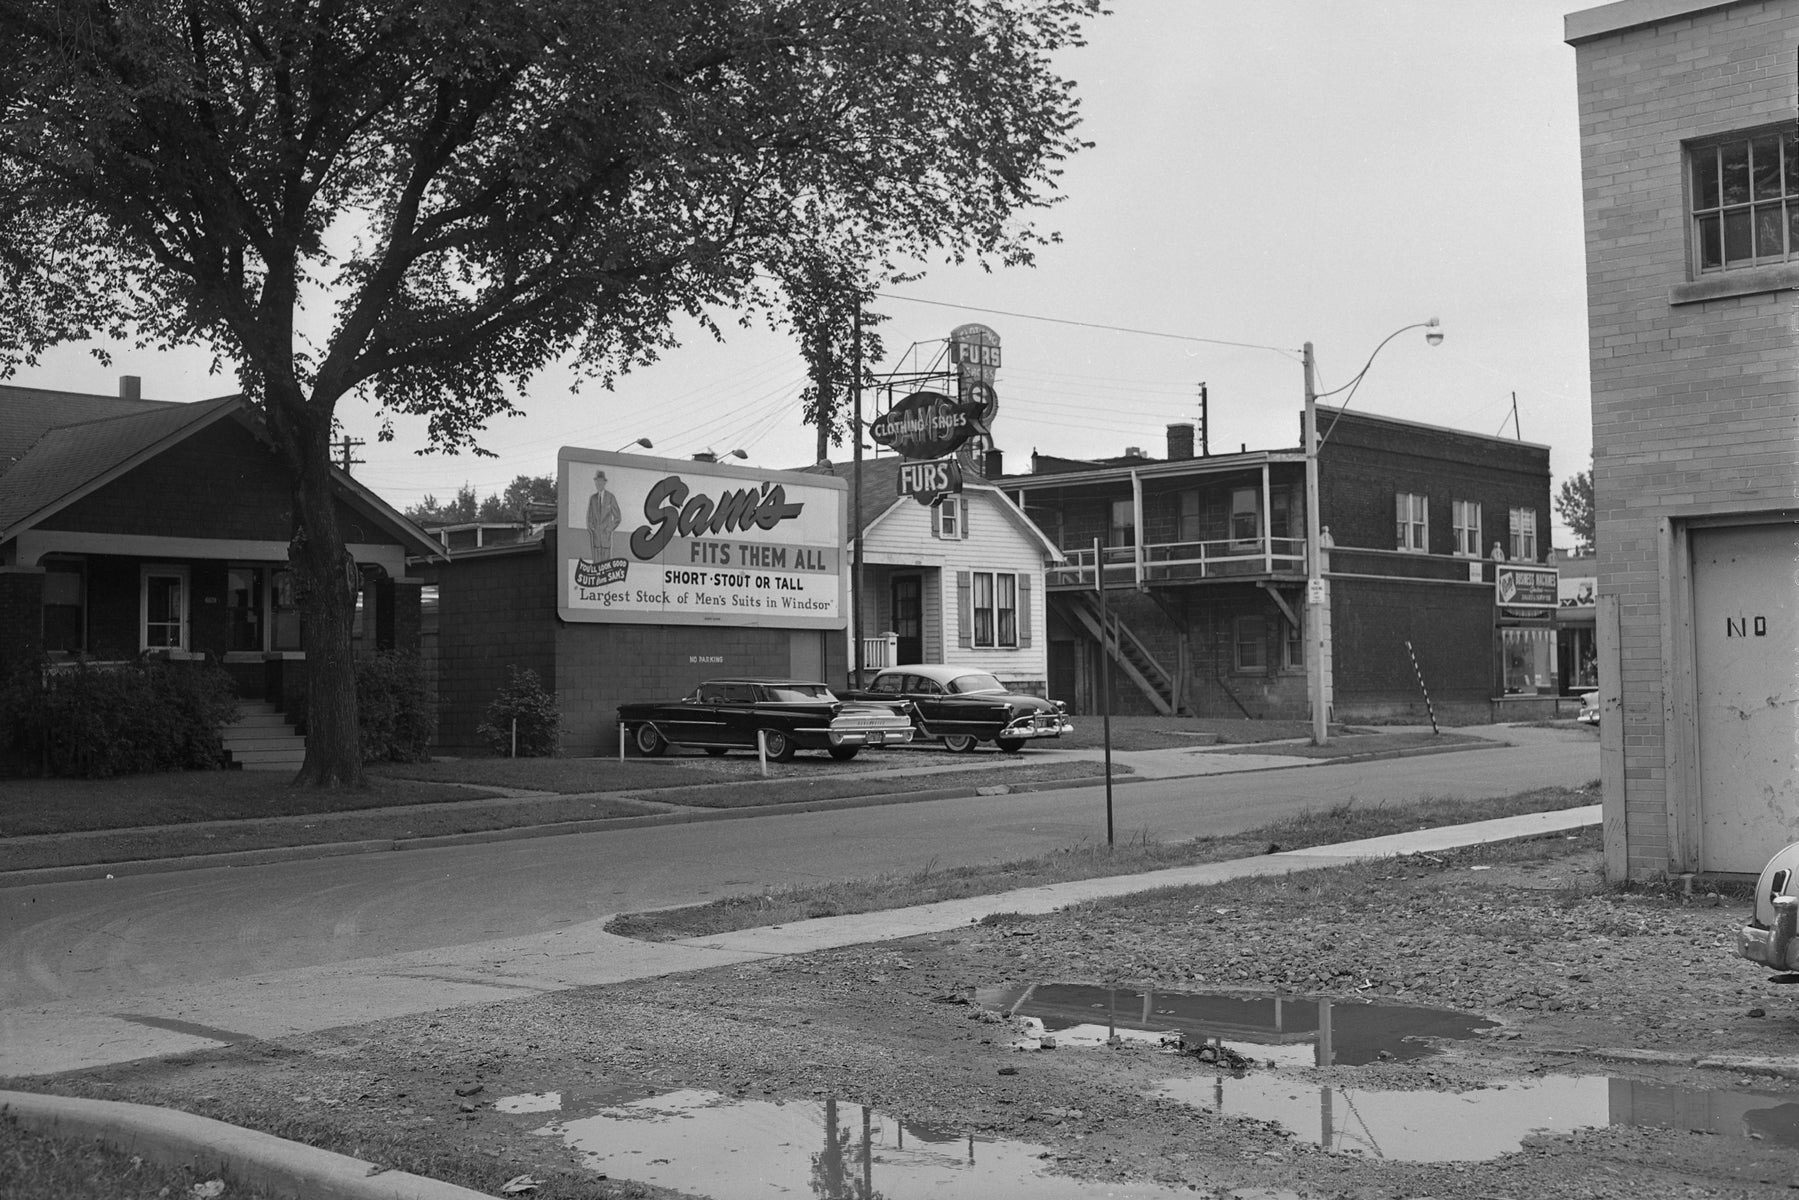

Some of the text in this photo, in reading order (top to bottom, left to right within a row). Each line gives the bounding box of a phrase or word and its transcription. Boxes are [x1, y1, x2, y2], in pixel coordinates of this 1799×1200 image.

[959, 343, 1000, 367] FURS
[874, 412, 967, 438] CLOTHING SHOES
[901, 463, 949, 494] FURS
[630, 476, 804, 561] Sam's
[598, 562, 612, 571] LOOK
[612, 559, 627, 568] GOOD
[690, 541, 826, 571] FITS THEM ALL
[577, 573, 596, 586] SUIT
[664, 570, 707, 585] SHORT
[755, 575, 771, 589] OR
[774, 577, 804, 591] TALL
[636, 590, 671, 604] Stock
[677, 592, 689, 604] of
[695, 592, 727, 606] Men's
[731, 594, 762, 608] Suits
[766, 596, 778, 608] in
[1727, 616, 1767, 637] NO
[689, 655, 724, 664] NO PARKING
